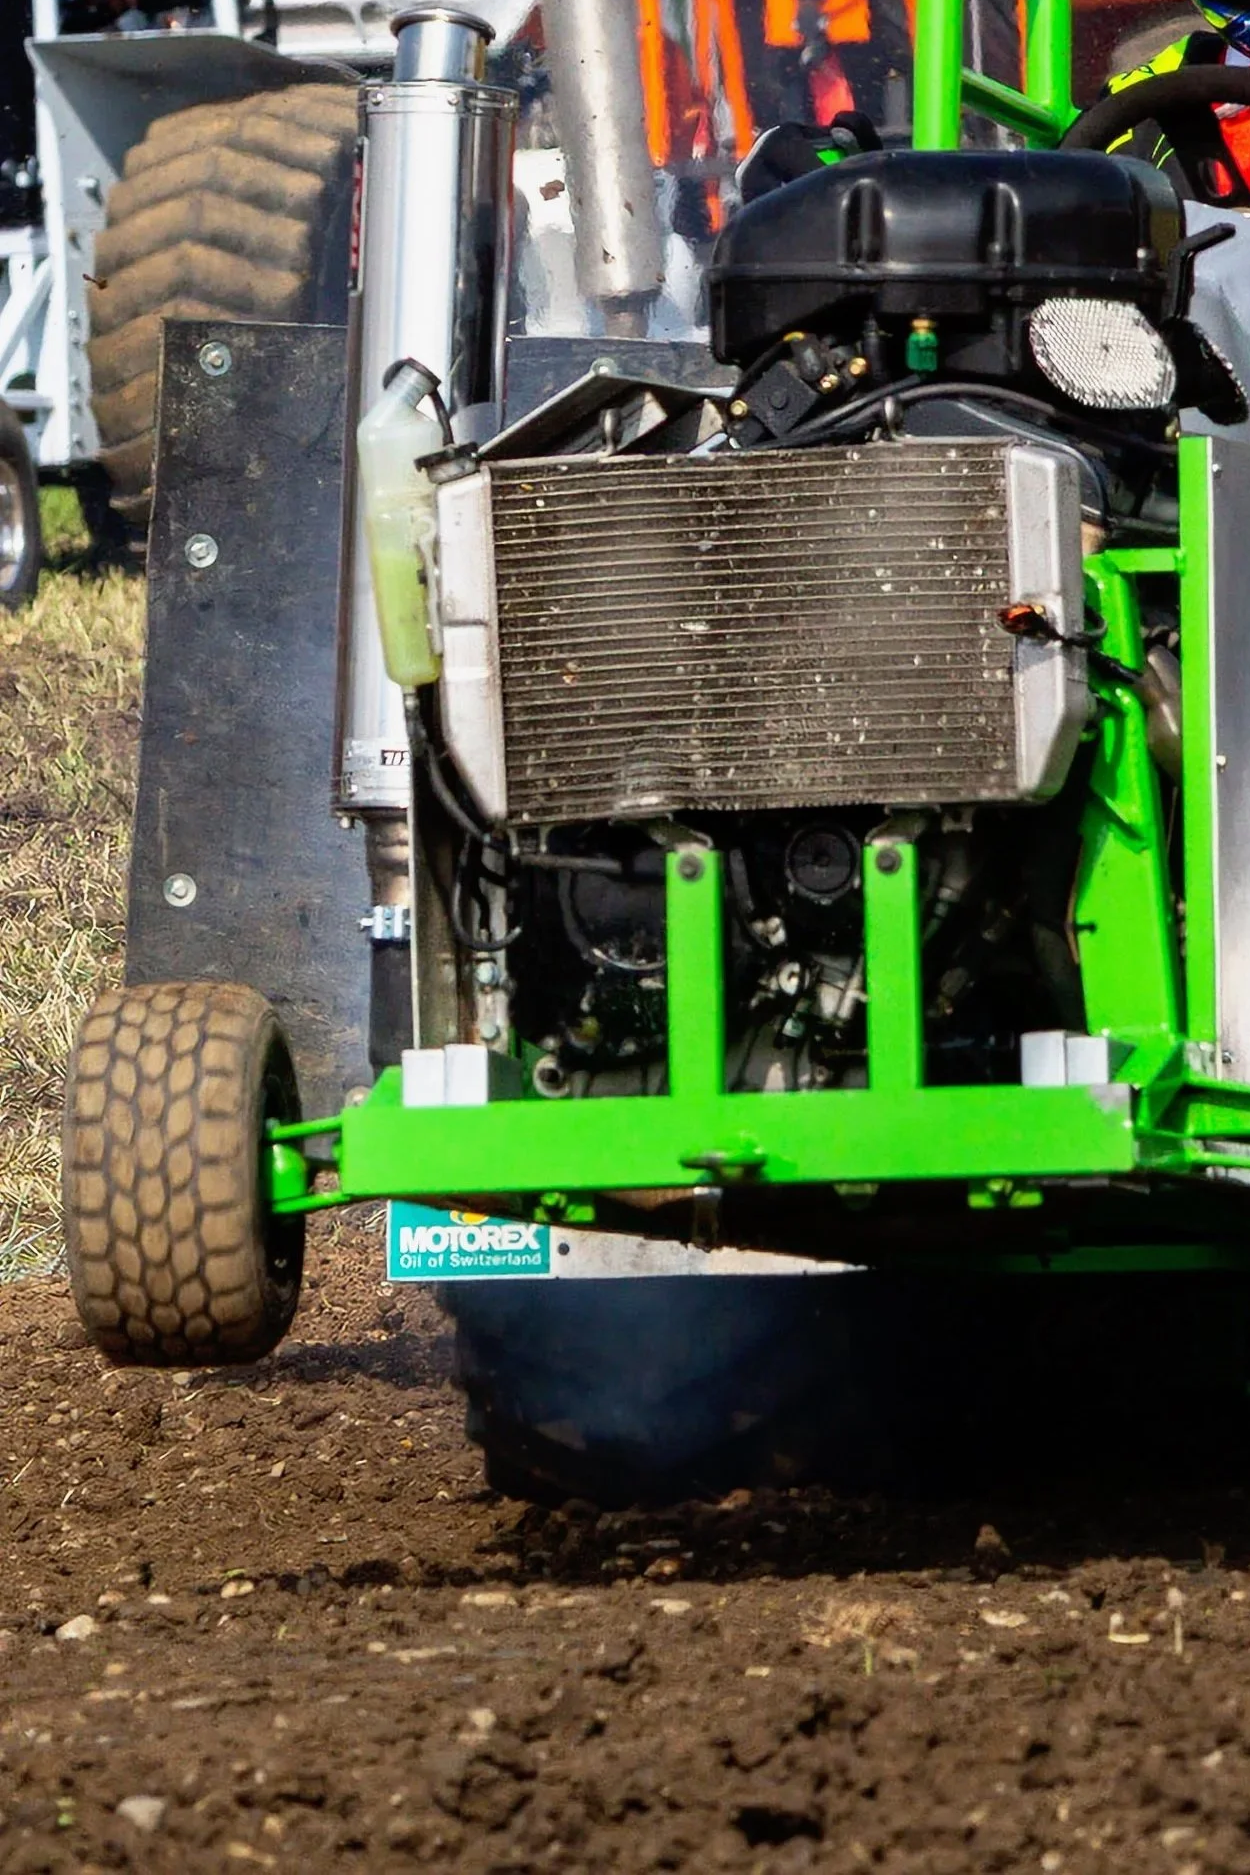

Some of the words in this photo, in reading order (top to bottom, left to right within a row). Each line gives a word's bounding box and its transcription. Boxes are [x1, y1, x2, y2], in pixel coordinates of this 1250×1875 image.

[400, 1224, 541, 1254] MOTOREX
[400, 1254, 422, 1269] Oil
[428, 1253, 444, 1268] of
[450, 1252, 542, 1268] Switzerland
